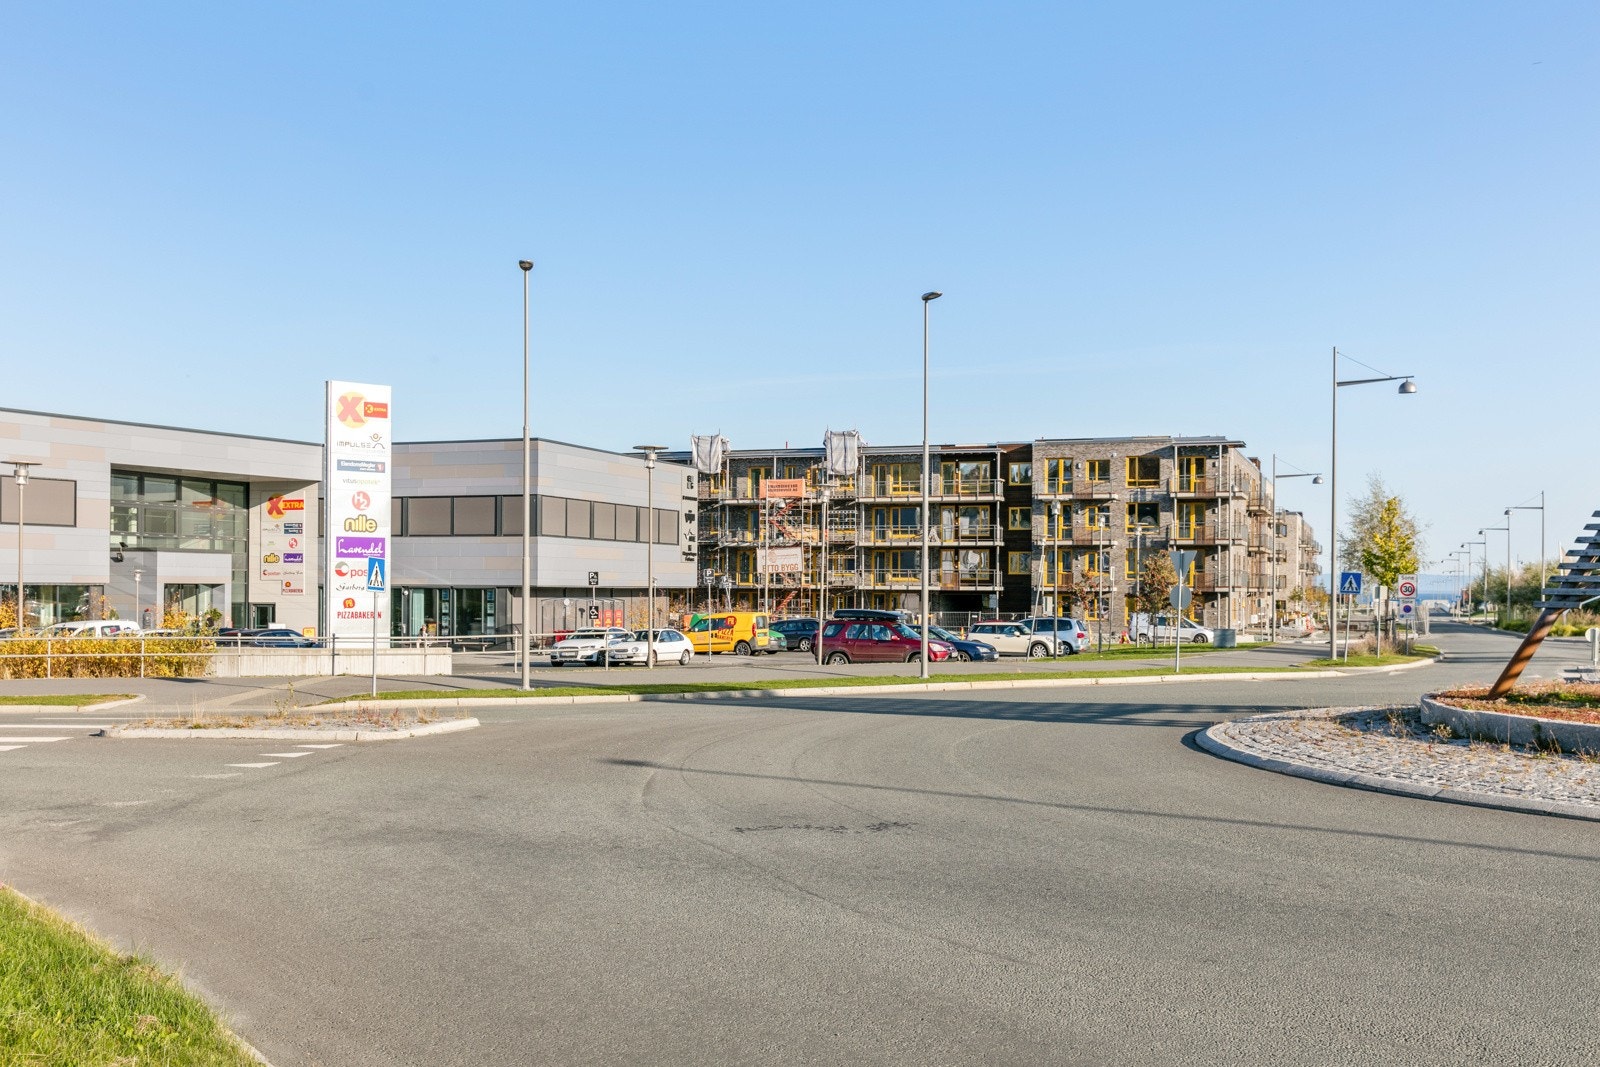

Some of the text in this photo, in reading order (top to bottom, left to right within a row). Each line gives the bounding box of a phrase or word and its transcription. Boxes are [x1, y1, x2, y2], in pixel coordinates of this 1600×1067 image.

[336, 440, 371, 448] IMPULSE
[283, 500, 304, 509] EXTRA
[344, 514, 378, 532] nille
[337, 611, 382, 619] PIZZABAKERN
